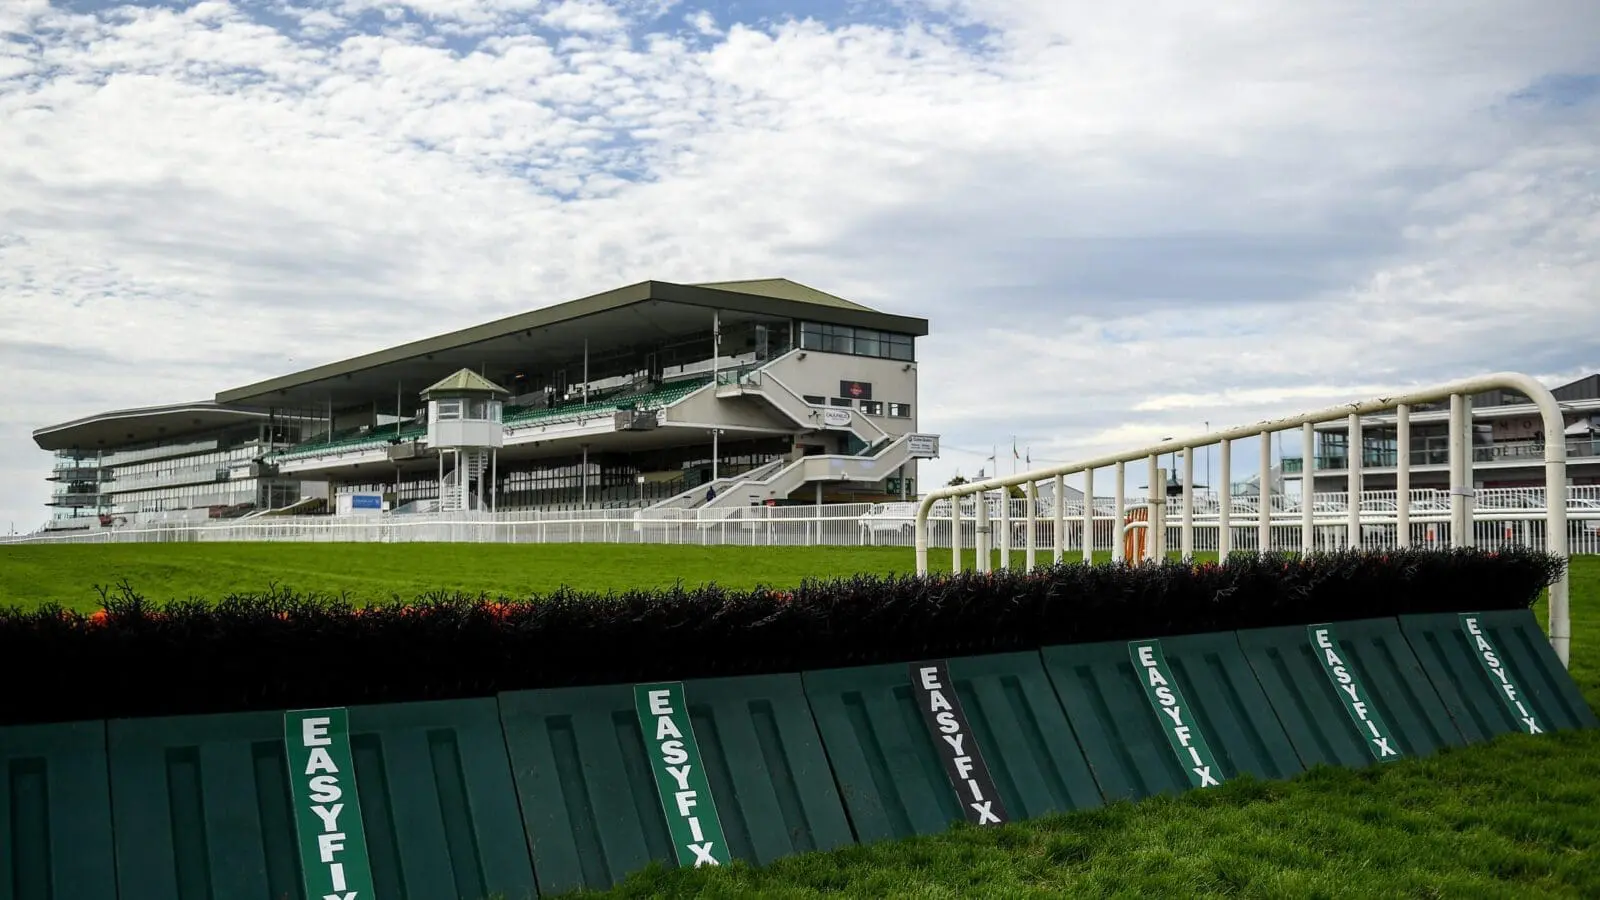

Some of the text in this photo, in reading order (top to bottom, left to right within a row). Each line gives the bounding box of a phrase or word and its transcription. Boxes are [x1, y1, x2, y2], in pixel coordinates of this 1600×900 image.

[919, 666, 1002, 825] EASYFIX
[1138, 646, 1220, 788] EASYFIX
[1315, 629, 1397, 757] EASYFIX
[1466, 618, 1543, 735] EASYFIX
[302, 717, 358, 900] EASYFI
[648, 689, 720, 869] EASYFIX
